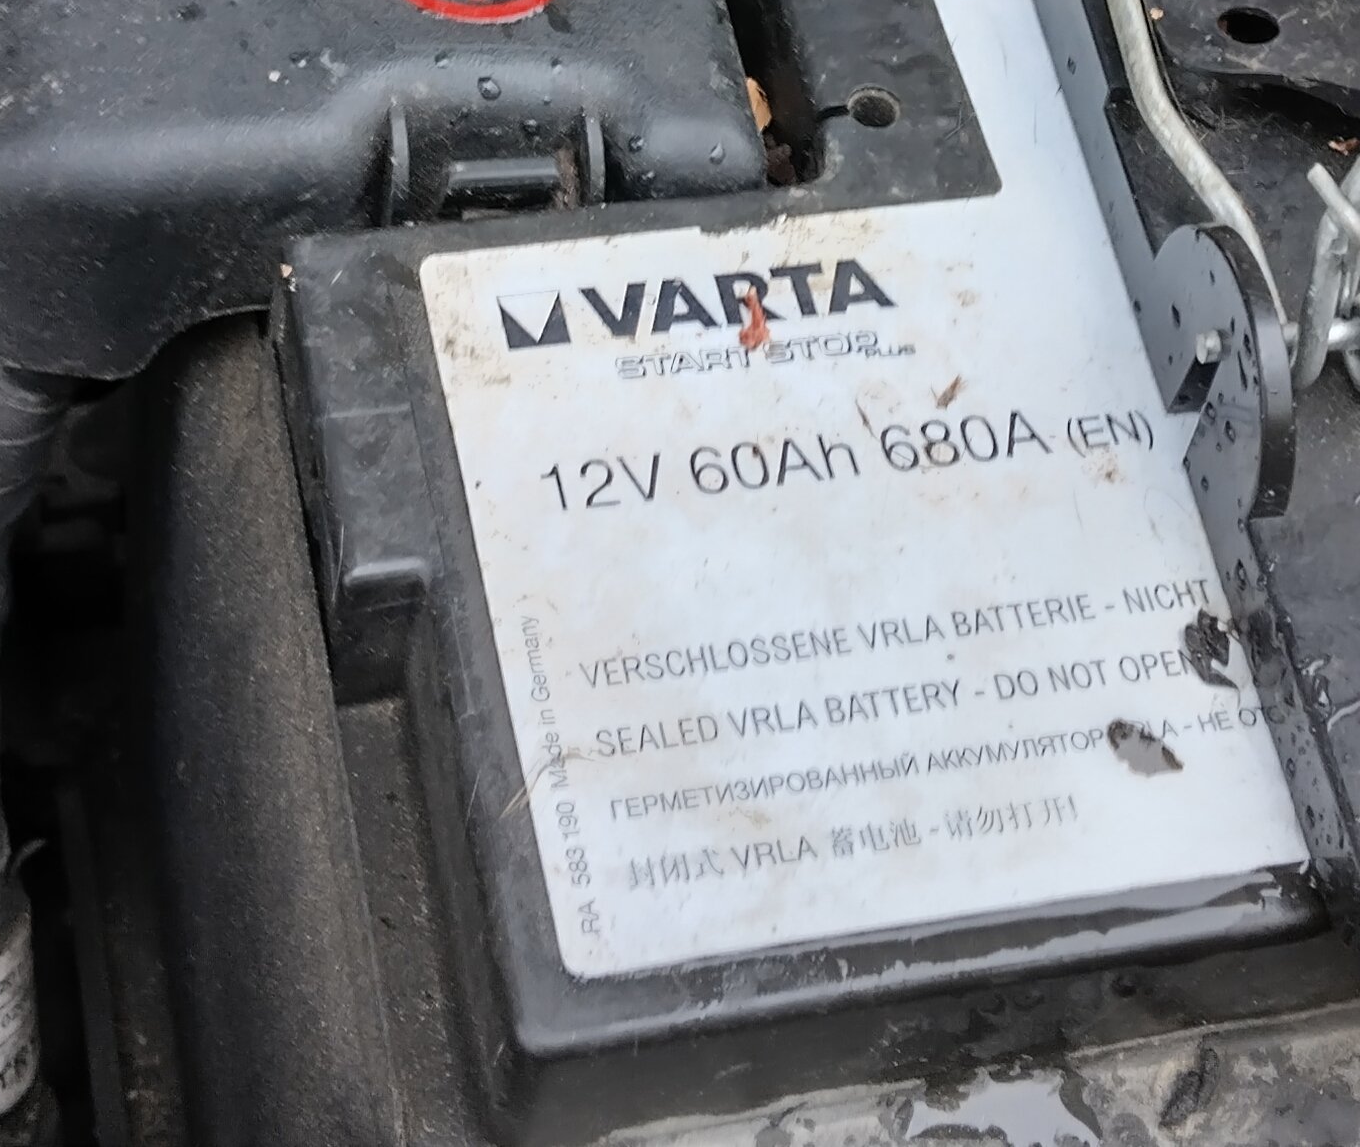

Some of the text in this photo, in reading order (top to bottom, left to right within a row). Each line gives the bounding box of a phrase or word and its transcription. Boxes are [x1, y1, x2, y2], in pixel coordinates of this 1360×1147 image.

[579, 258, 898, 338] VARTA
[615, 346, 753, 379] START
[764, 330, 879, 365] STOP
[540, 409, 1154, 511] 12V 60Ah 680A (EN)
[521, 615, 551, 702] Germany
[579, 628, 853, 689] VERSCHLOSSENE
[856, 614, 945, 652] VRLA
[951, 593, 1096, 637] BATTERIE
[1122, 579, 1211, 615] NICHT
[539, 708, 556, 725] in
[596, 715, 719, 757] SEALED
[727, 700, 818, 739] VRLA
[825, 679, 961, 726] BATTERY
[993, 669, 1038, 701] DO
[1047, 658, 1111, 693] NOT
[610, 751, 920, 821] ГЕРМЕТИЗИРОВАННЫЙ
[927, 727, 1104, 773] АККУМУЛЯТОР
[1197, 708, 1234, 733] НЕ
[556, 801, 581, 841] 190
[730, 835, 818, 880] VRLA
[566, 847, 591, 889] 583
